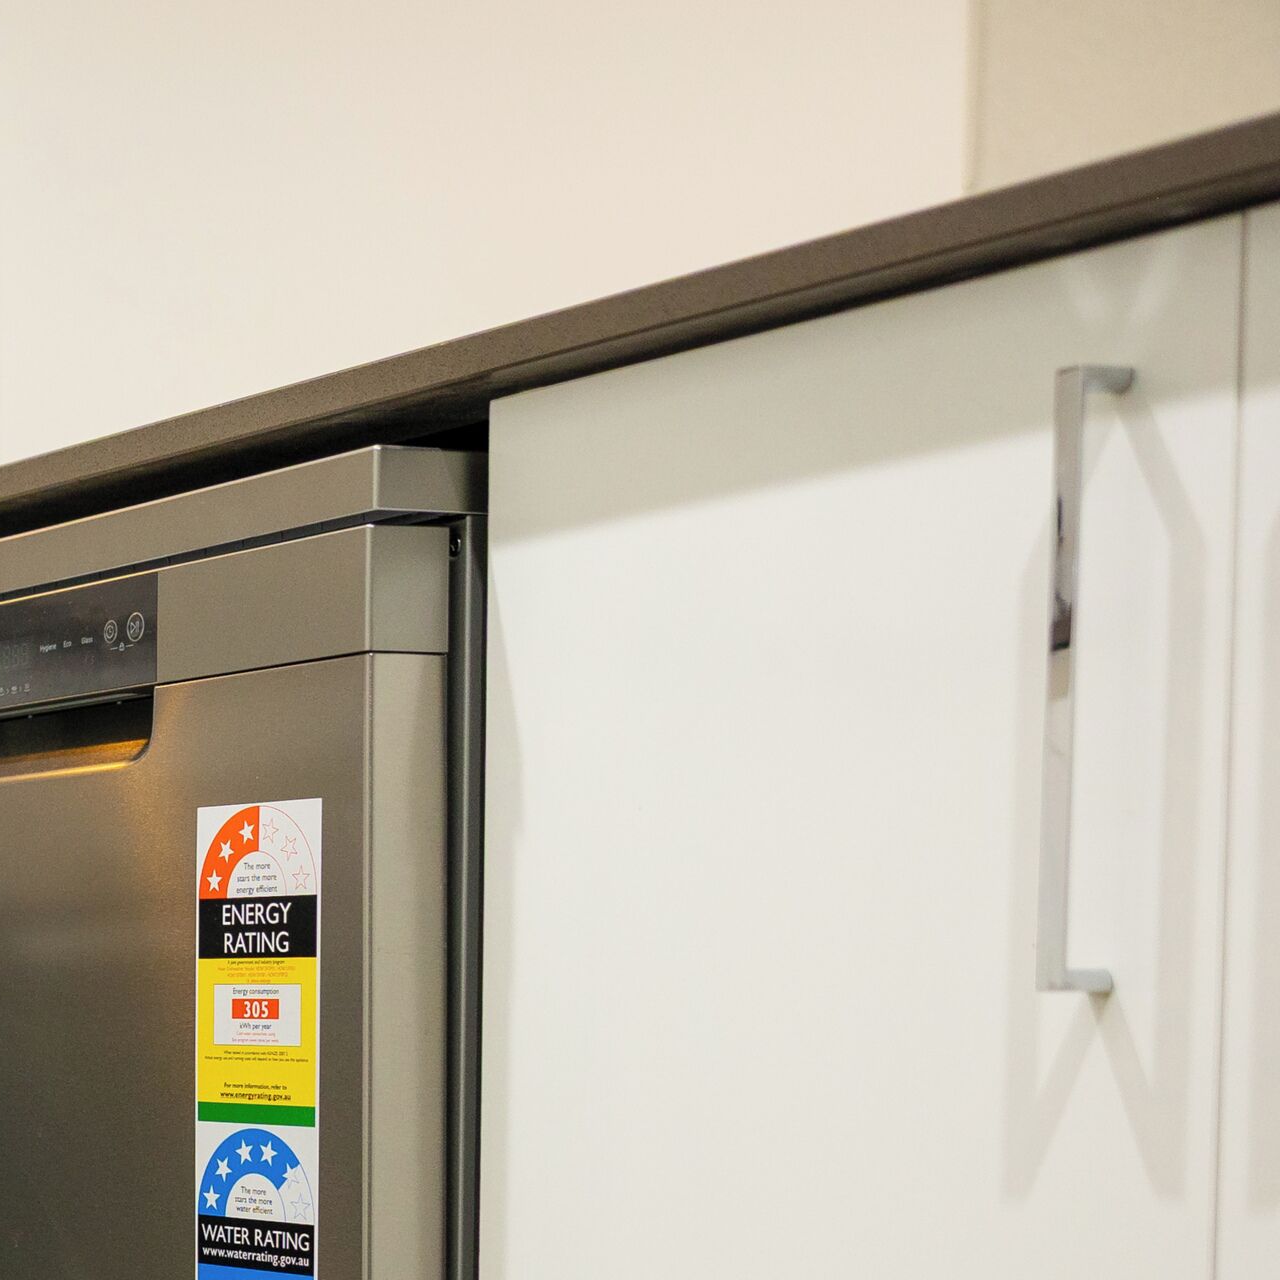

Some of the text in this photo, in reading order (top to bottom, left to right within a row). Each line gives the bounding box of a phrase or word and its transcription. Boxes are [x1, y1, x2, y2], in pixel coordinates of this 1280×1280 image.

[39, 642, 57, 654] Hygiene
[63, 640, 72, 649] Eco
[243, 862, 271, 871] The more
[252, 874, 261, 882] the
[262, 874, 277, 882] more
[236, 885, 278, 895] energy efficient
[222, 902, 292, 926] ENERGY
[223, 931, 290, 954] RATING
[232, 987, 279, 995] Energy consumption
[243, 1000, 269, 1018] 305
[252, 1023, 261, 1031] per
[261, 1023, 272, 1032] year
[220, 1090, 291, 1102] www.energyrating.gov.au
[241, 1185, 267, 1196] The more
[234, 1196, 273, 1206] stars the more
[236, 1205, 273, 1215] water efficient
[201, 1223, 310, 1251] WATER RATING
[202, 1246, 310, 1268] www.waterrating.gov.au
